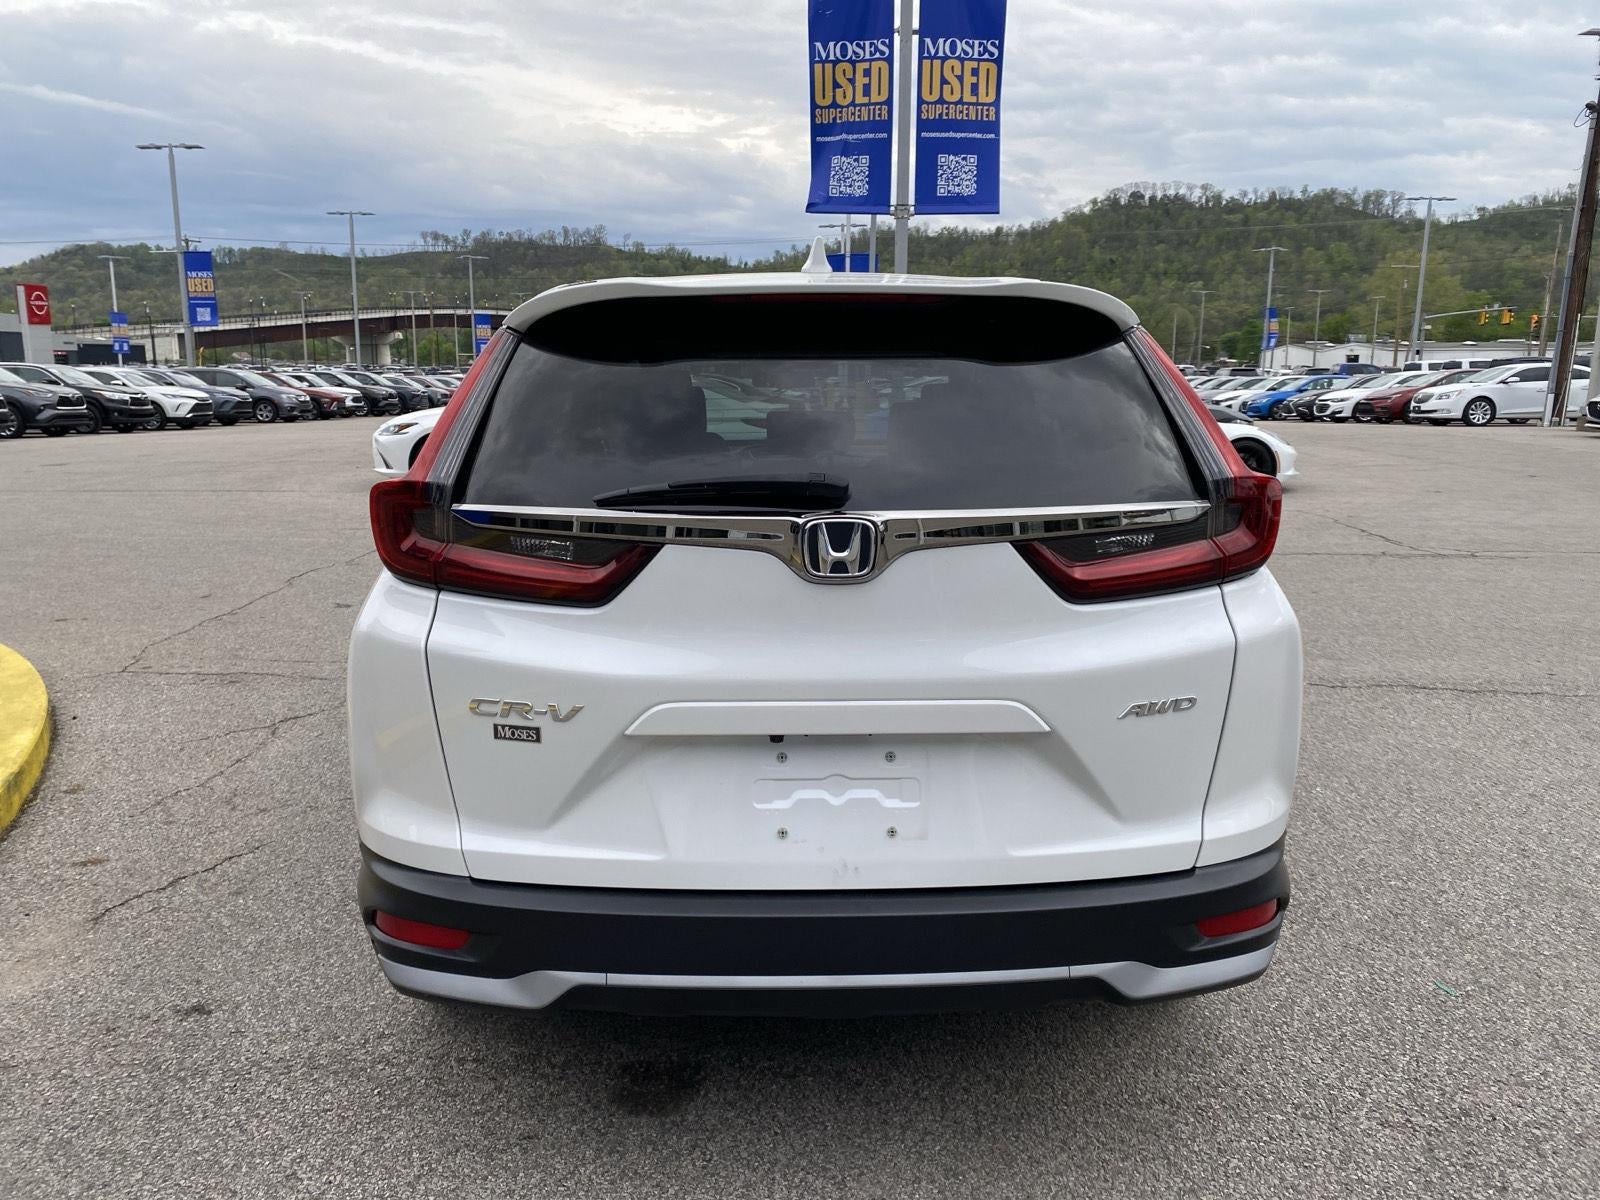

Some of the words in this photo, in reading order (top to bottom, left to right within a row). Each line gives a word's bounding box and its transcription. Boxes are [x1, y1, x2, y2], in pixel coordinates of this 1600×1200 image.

[814, 38, 889, 61] MOSES
[923, 37, 999, 60] MOSES
[814, 60, 889, 107] USED
[921, 58, 998, 103] USED
[815, 105, 888, 124] SUPERCENTER
[921, 103, 996, 121] SUPERCENTER
[921, 130, 995, 139] mosesusedsupercenter.com
[187, 278, 214, 292] USED
[468, 697, 585, 723] CR-V
[1116, 695, 1198, 720] AWD
[496, 726, 537, 741] MOSES
